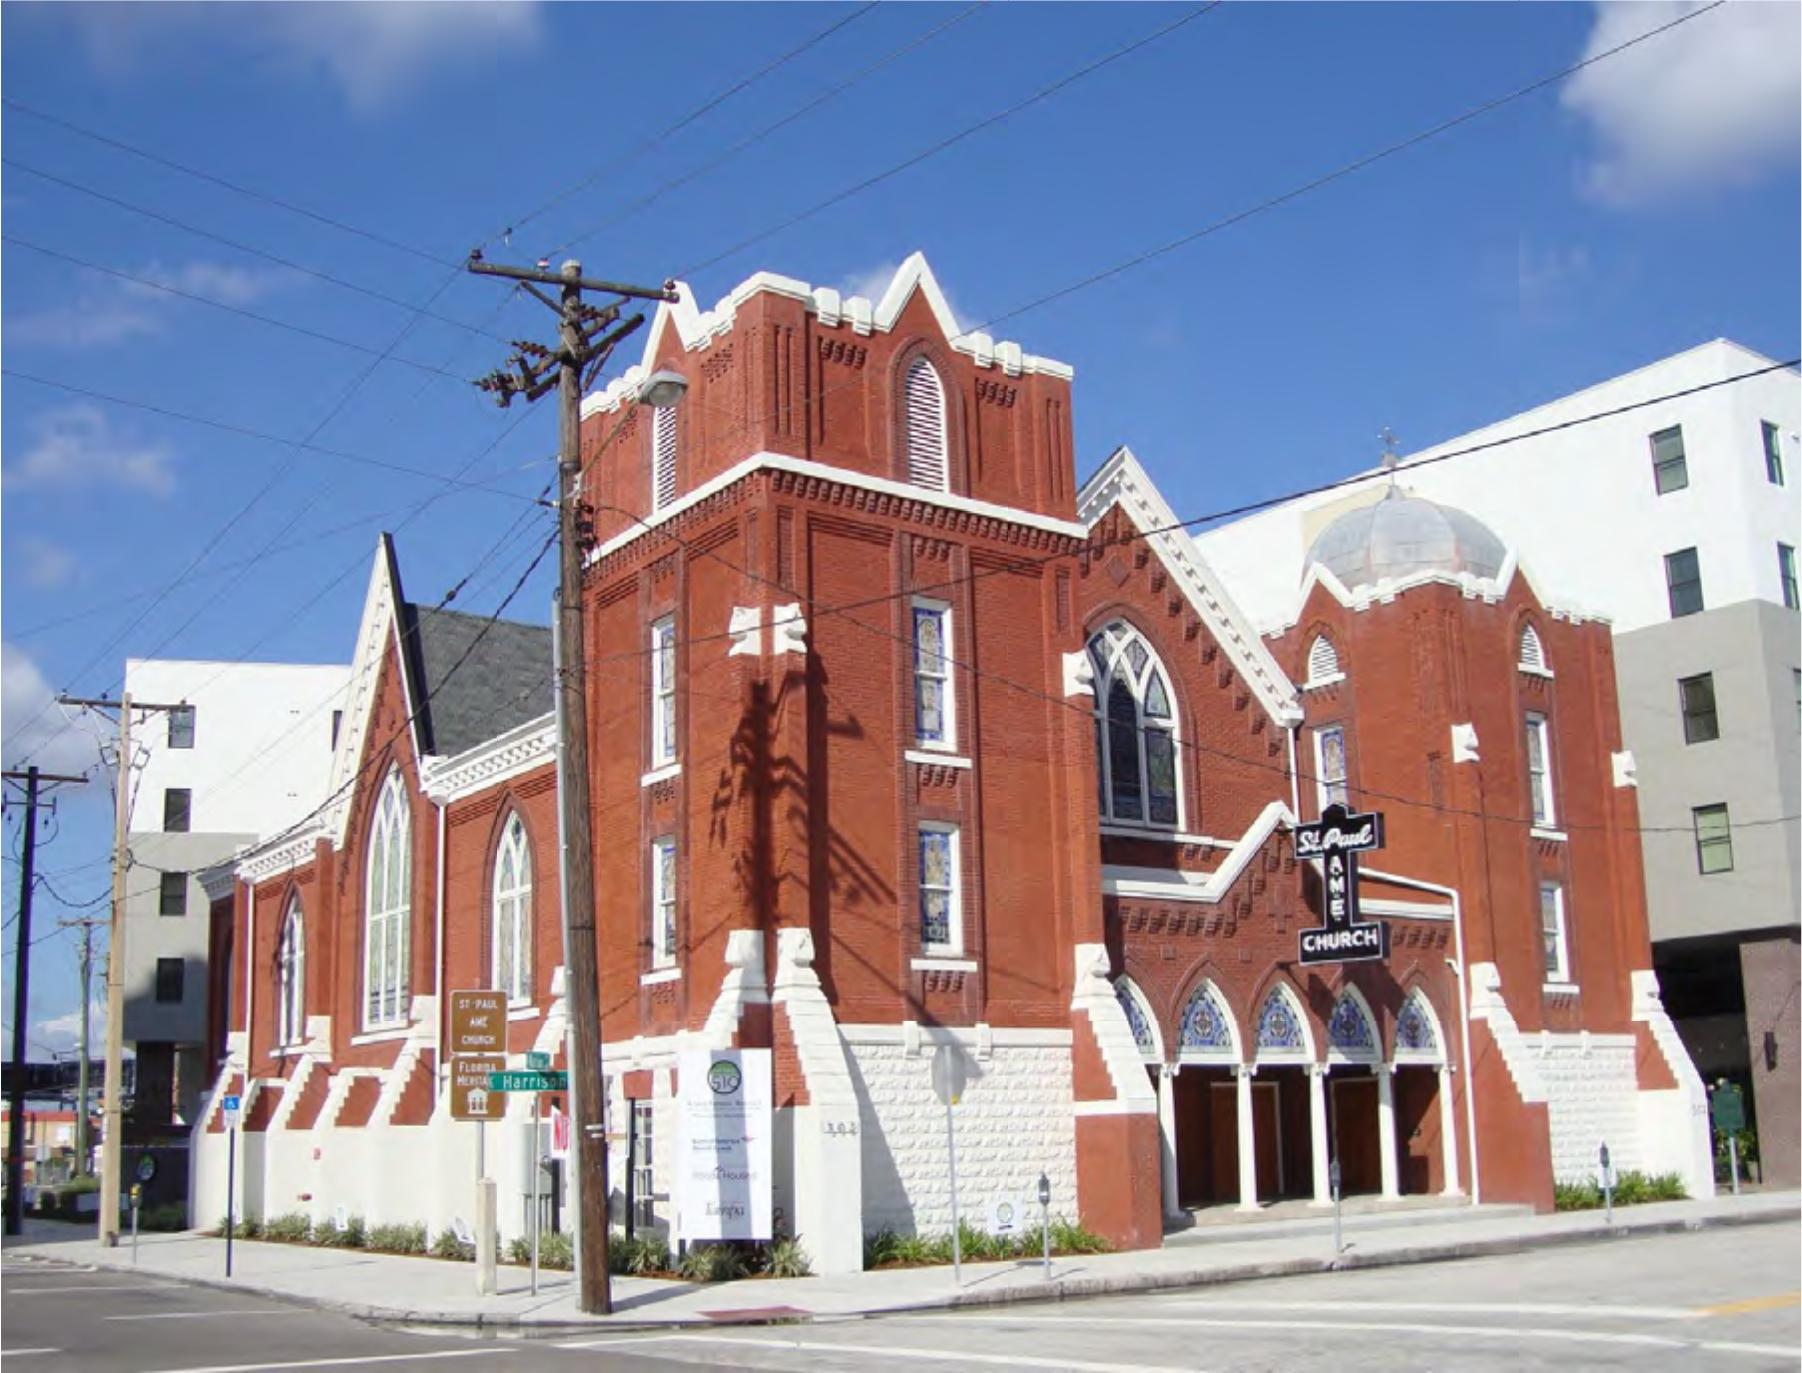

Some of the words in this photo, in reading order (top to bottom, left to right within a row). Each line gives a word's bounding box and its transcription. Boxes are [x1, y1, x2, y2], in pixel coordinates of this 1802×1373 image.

[1323, 824, 1373, 850] Paul
[1303, 928, 1378, 952] CHURCH
[475, 999, 498, 1010] PAUL
[469, 1016, 489, 1028] AME
[461, 1034, 496, 1045] CHURCH
[502, 1075, 567, 1089] Harrison
